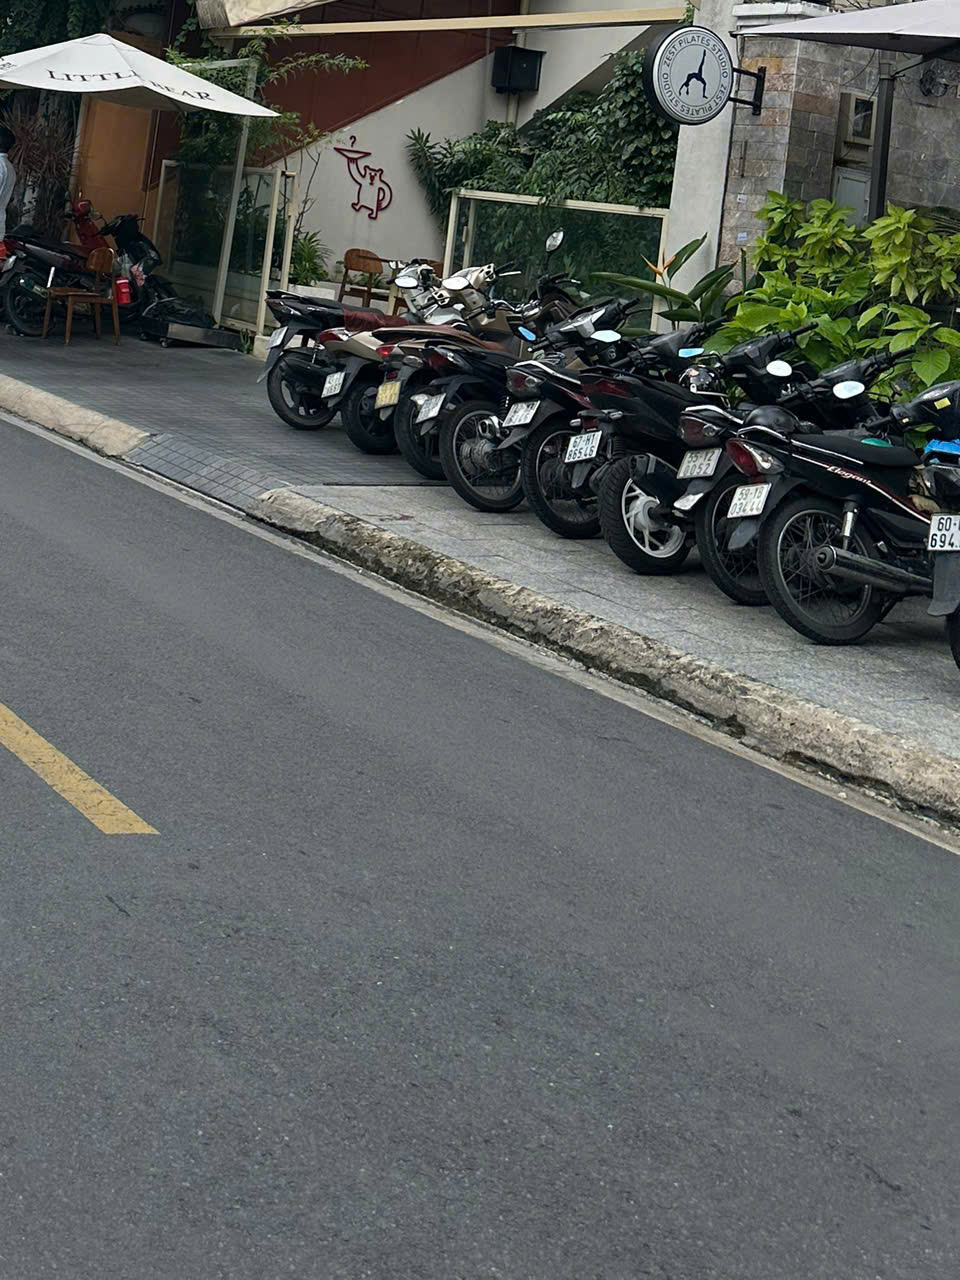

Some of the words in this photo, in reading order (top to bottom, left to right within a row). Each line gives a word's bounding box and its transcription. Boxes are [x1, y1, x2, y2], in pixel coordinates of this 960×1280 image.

[663, 44, 678, 68] ZEST
[678, 35, 711, 48] PILATES
[711, 44, 729, 79] STUDIO
[662, 72, 680, 107] STUDIO
[713, 83, 727, 106] ZEST
[680, 104, 713, 116] PILATES
[937, 516, 960, 531] 60-
[930, 533, 960, 548] 694.
